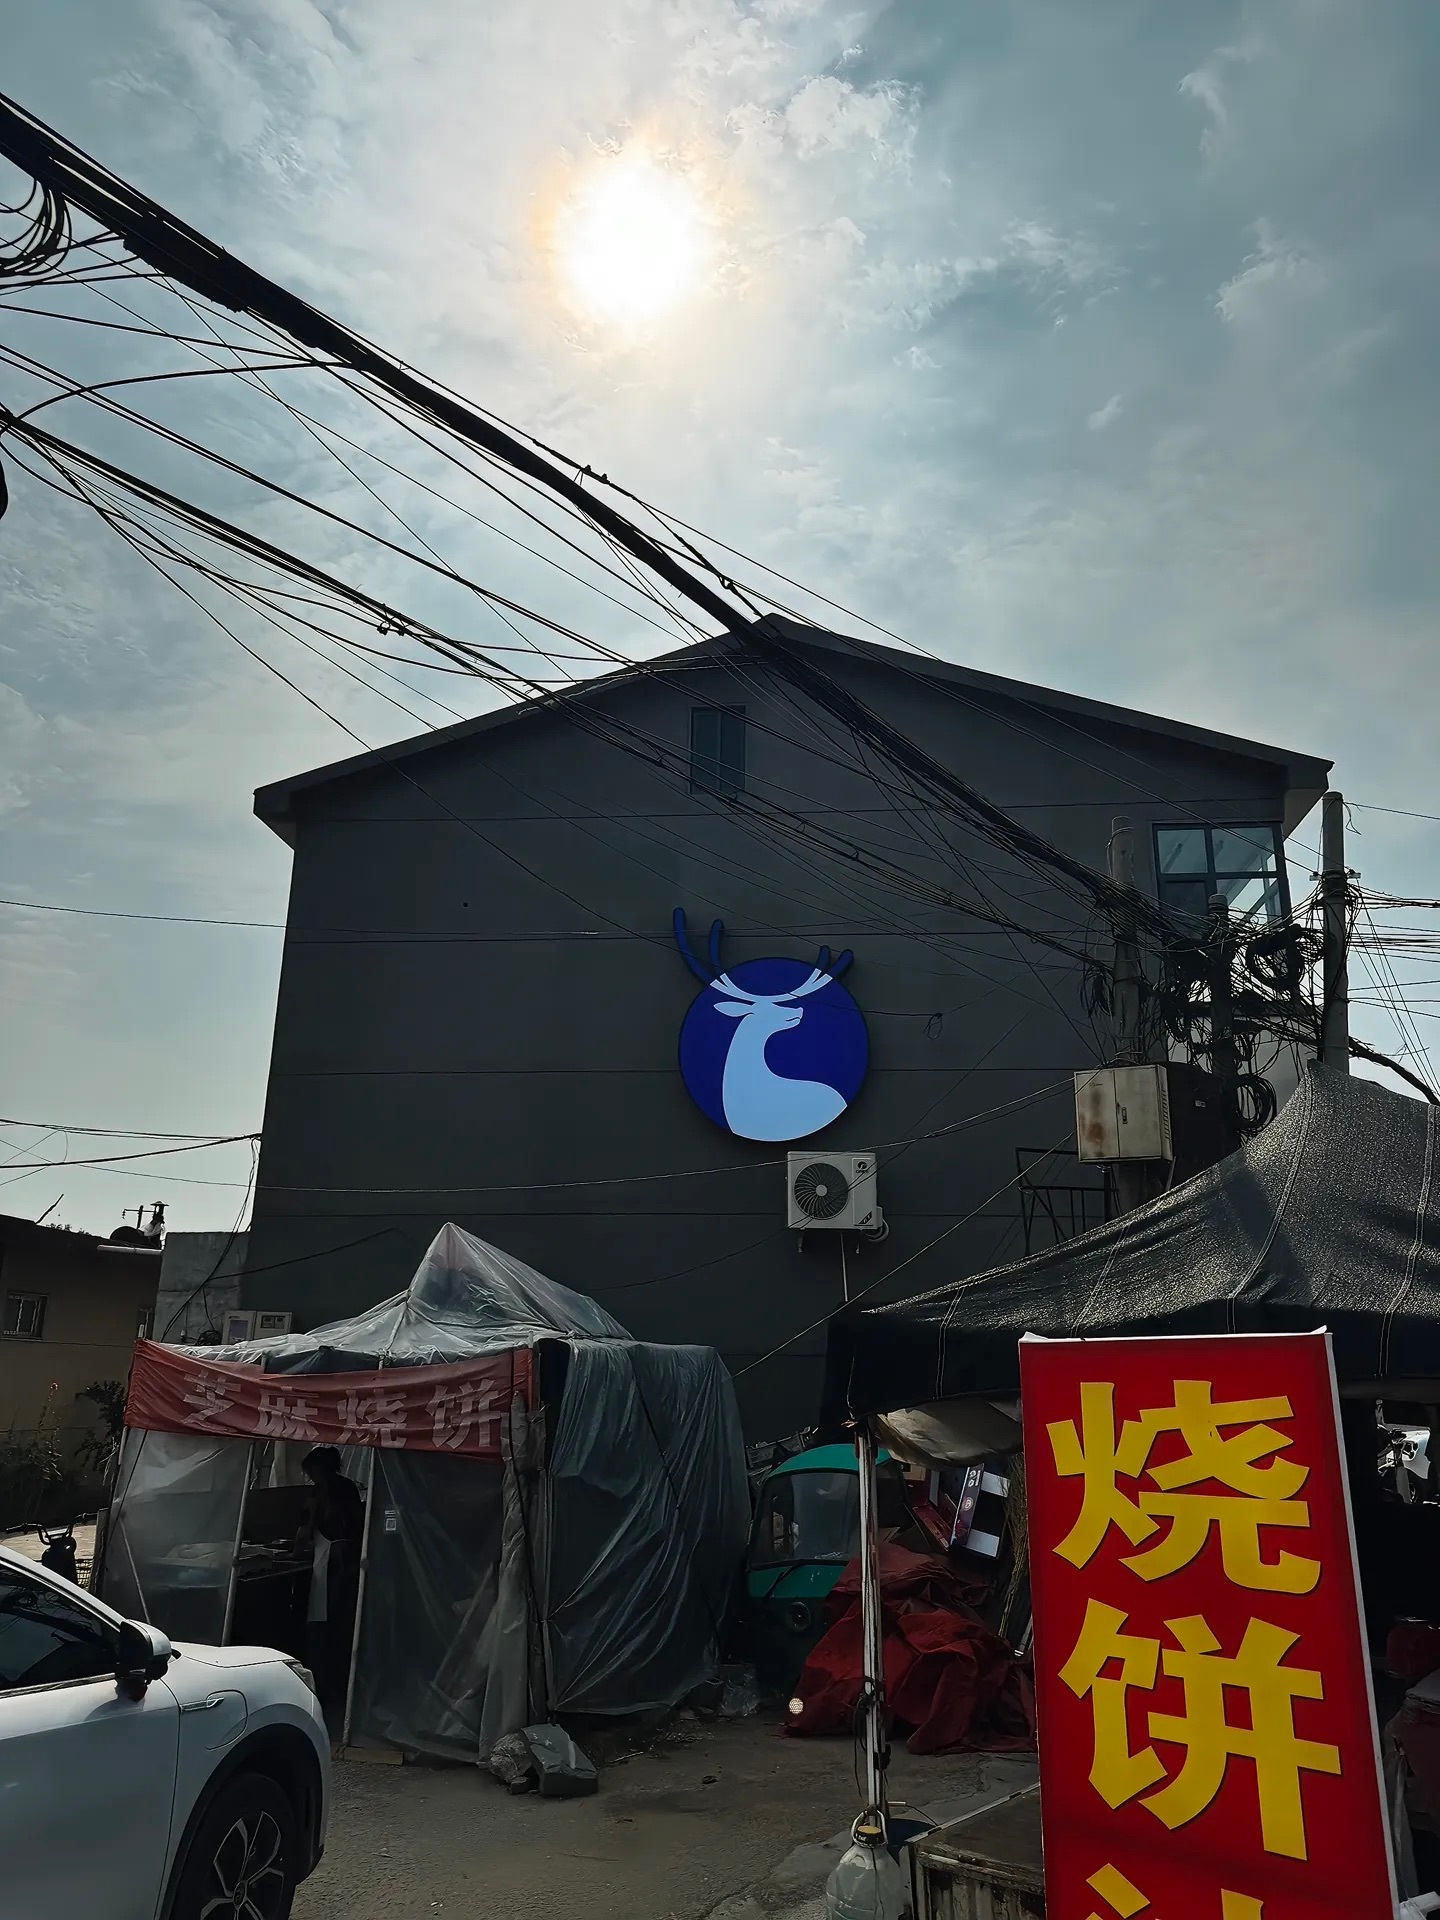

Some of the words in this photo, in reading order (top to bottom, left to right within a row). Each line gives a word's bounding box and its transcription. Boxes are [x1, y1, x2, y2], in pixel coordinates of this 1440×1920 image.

[181, 1371, 503, 1449] 芝麻烧饼
[1046, 1379, 1341, 1920] 烧饼
